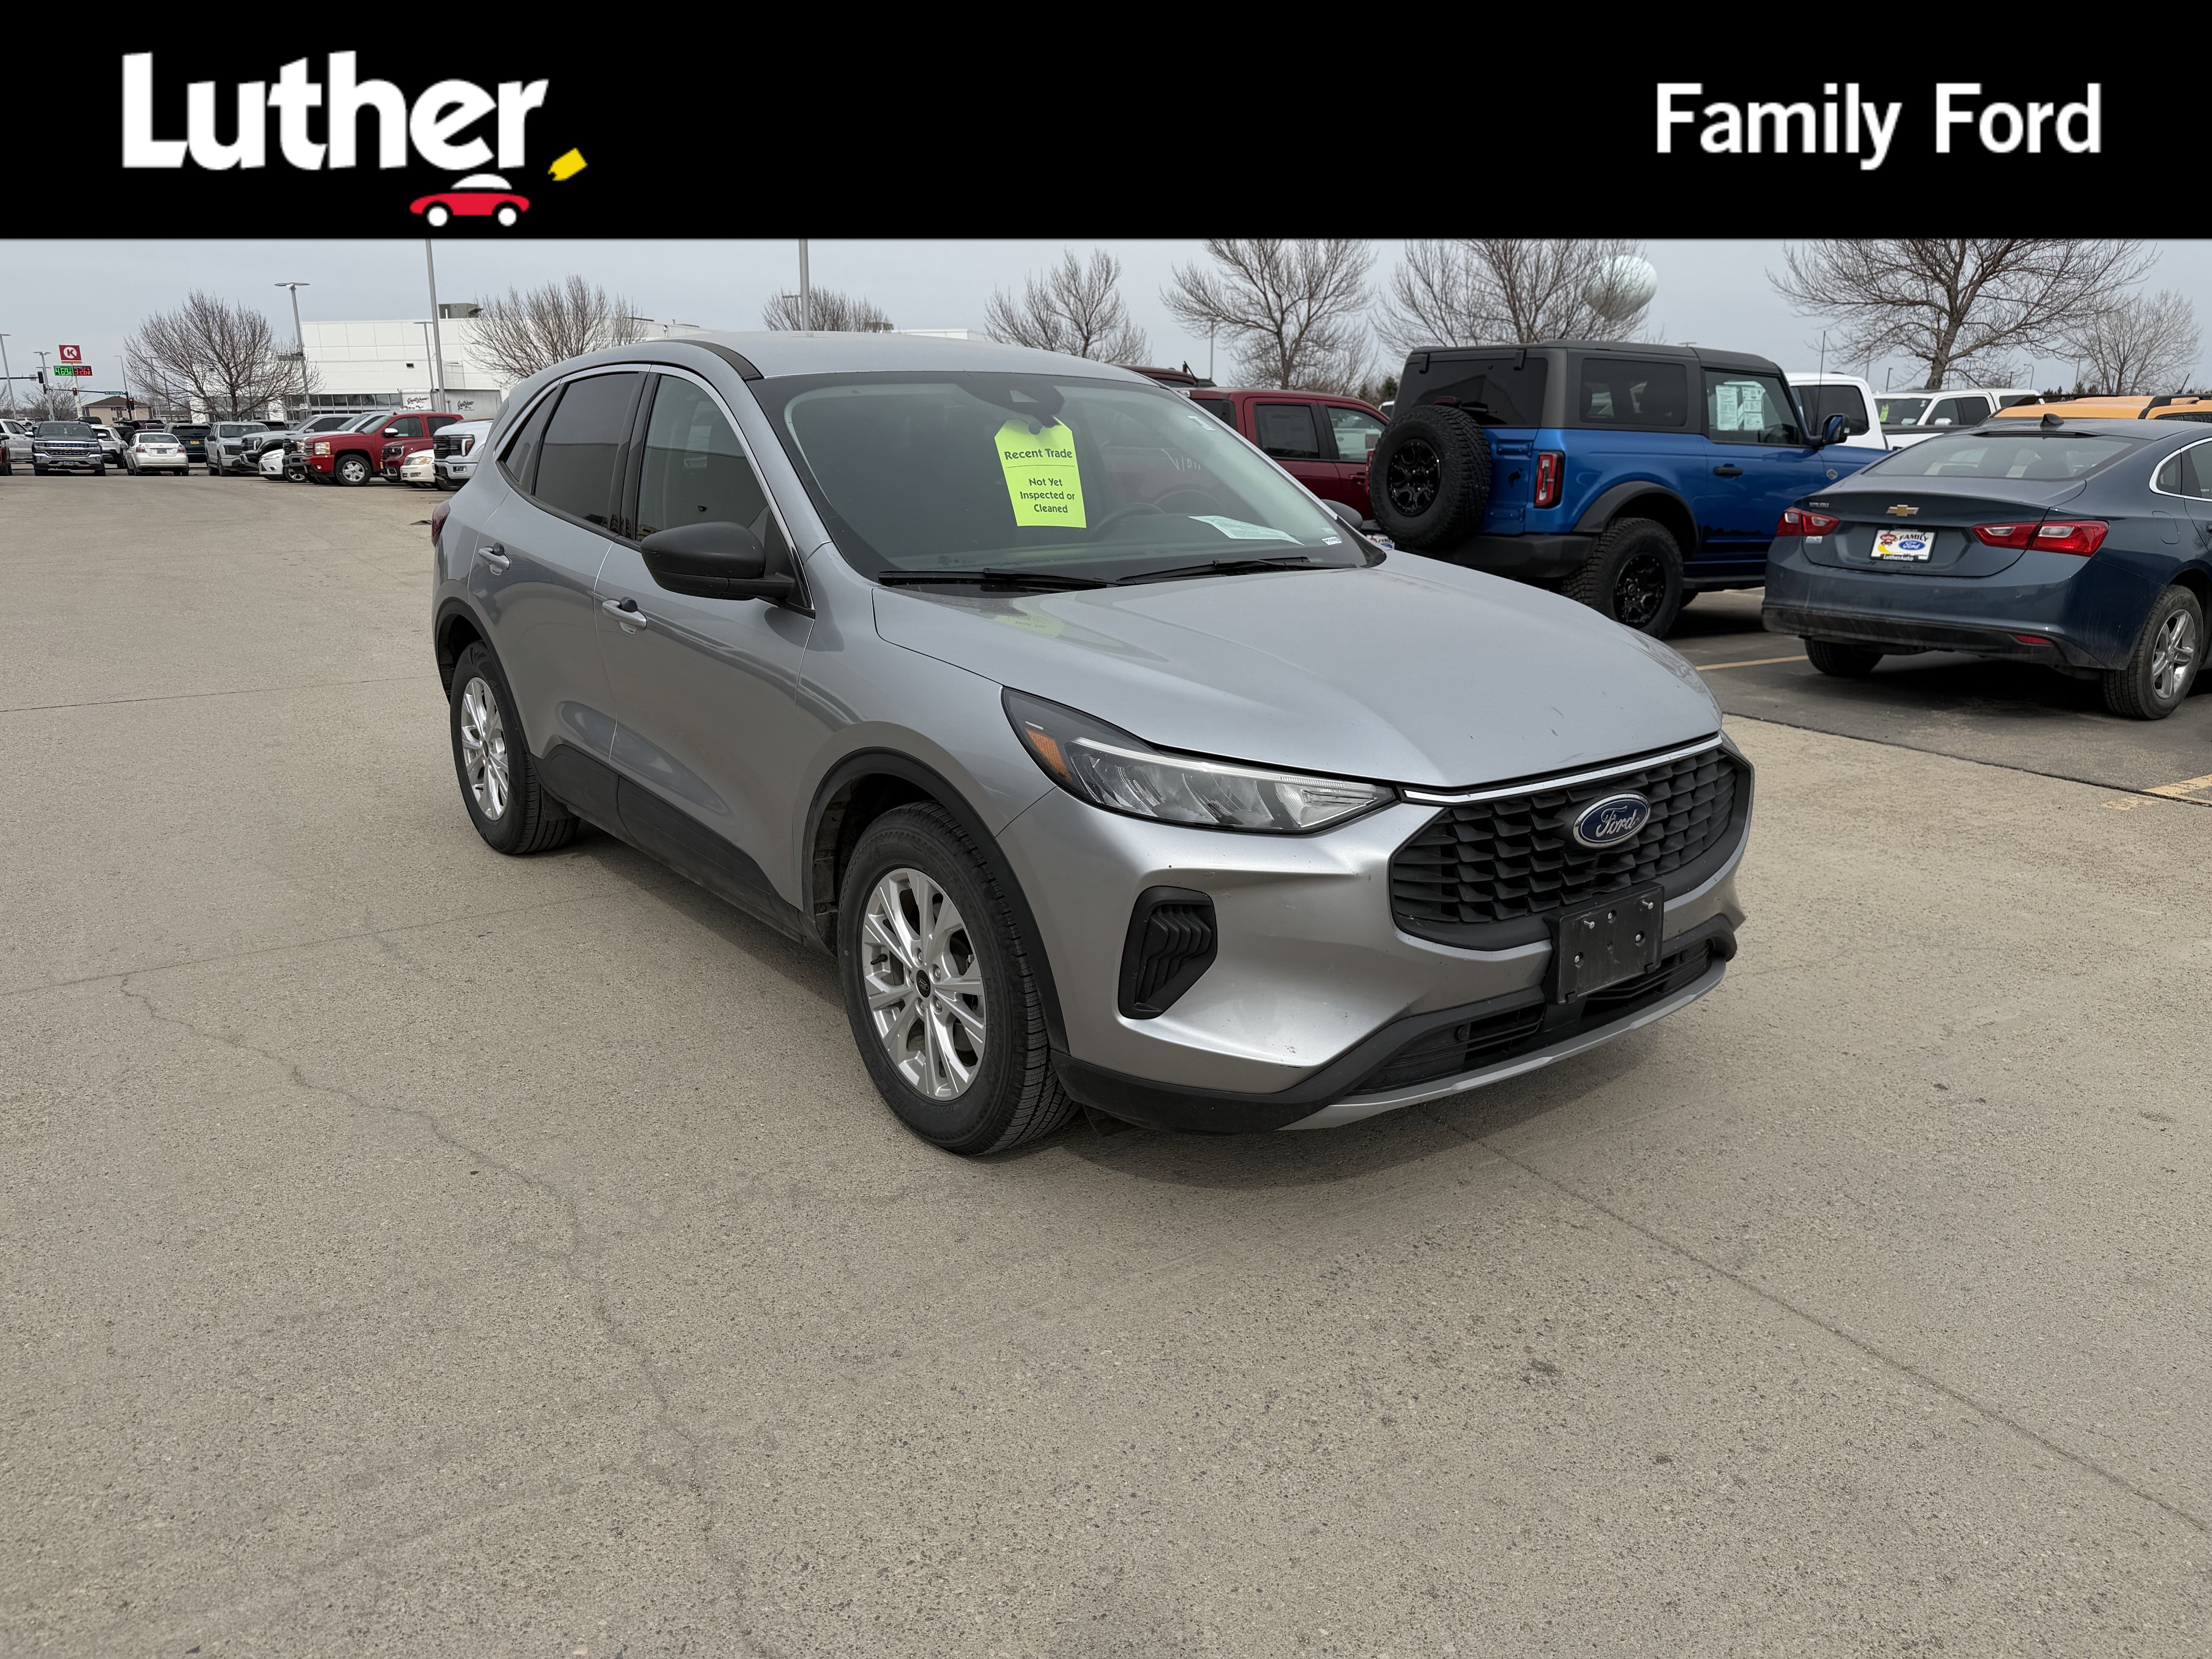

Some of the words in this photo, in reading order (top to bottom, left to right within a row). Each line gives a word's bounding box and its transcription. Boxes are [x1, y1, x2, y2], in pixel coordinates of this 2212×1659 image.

[1005, 449, 1043, 460] Recent
[1045, 448, 1072, 458] Trade
[1029, 478, 1046, 486] Not
[1048, 478, 1063, 486] Yet
[1020, 491, 1064, 500] Inspected
[1034, 504, 1068, 513] Cleaned
[1595, 805, 1637, 837] Ford
